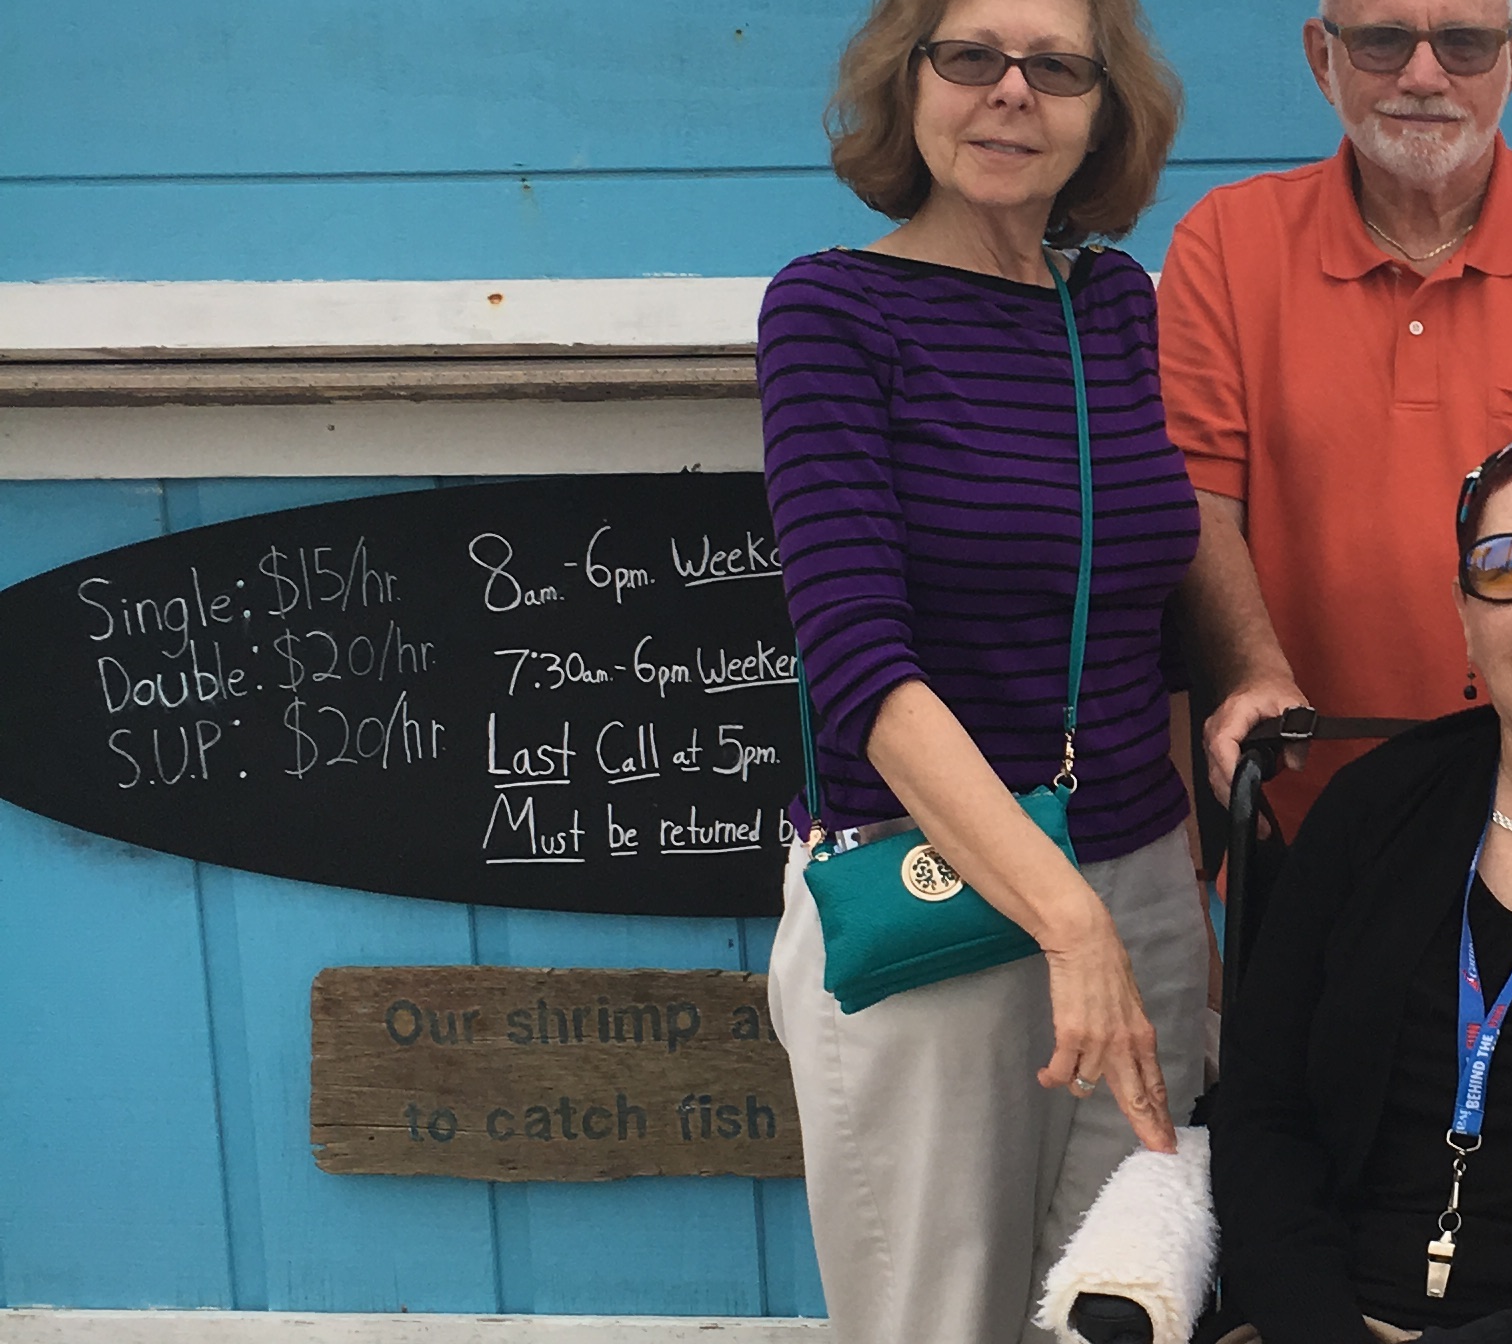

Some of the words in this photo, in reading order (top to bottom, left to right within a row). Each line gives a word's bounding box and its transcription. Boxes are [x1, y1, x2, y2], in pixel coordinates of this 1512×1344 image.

[488, 712, 577, 777] Last
[596, 720, 659, 774] Call
[672, 727, 703, 765] at
[482, 792, 586, 855] Must
[607, 803, 639, 848] be
[660, 805, 762, 846] returned
[384, 999, 481, 1047] Our
[506, 997, 702, 1053] shrimp
[1465, 1060, 1486, 1110] BEHIND
[1476, 1034, 1495, 1058] THE
[404, 1101, 459, 1143] to
[486, 1093, 648, 1142] catch
[675, 1093, 777, 1142] fish
